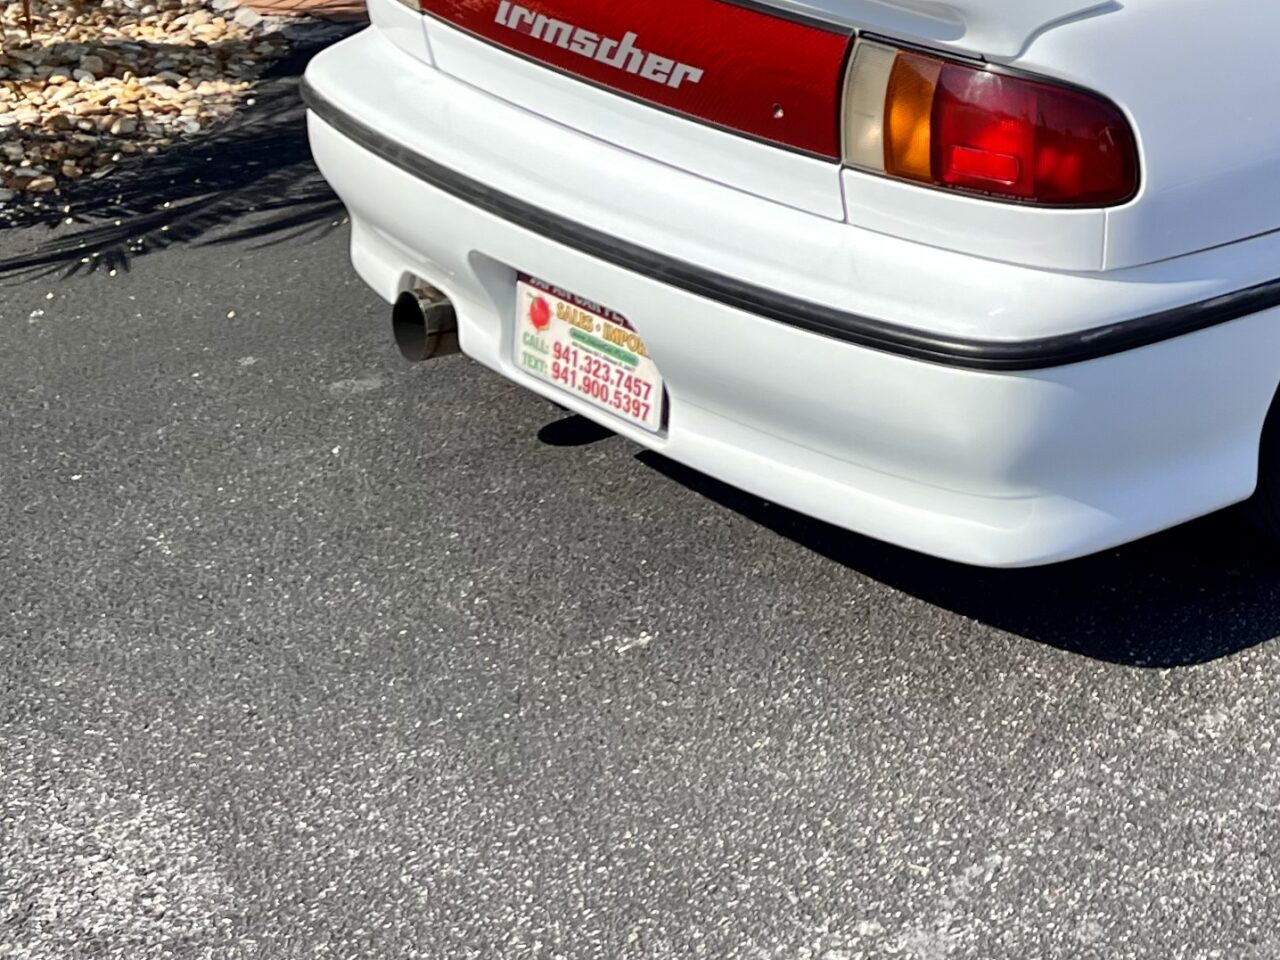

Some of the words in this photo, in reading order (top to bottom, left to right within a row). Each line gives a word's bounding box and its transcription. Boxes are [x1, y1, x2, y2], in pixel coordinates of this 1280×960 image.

[556, 301, 594, 333] SALES
[523, 331, 550, 355] CALL:
[553, 341, 652, 401] 941.323.7457
[551, 362, 651, 422] 941.900.5397
